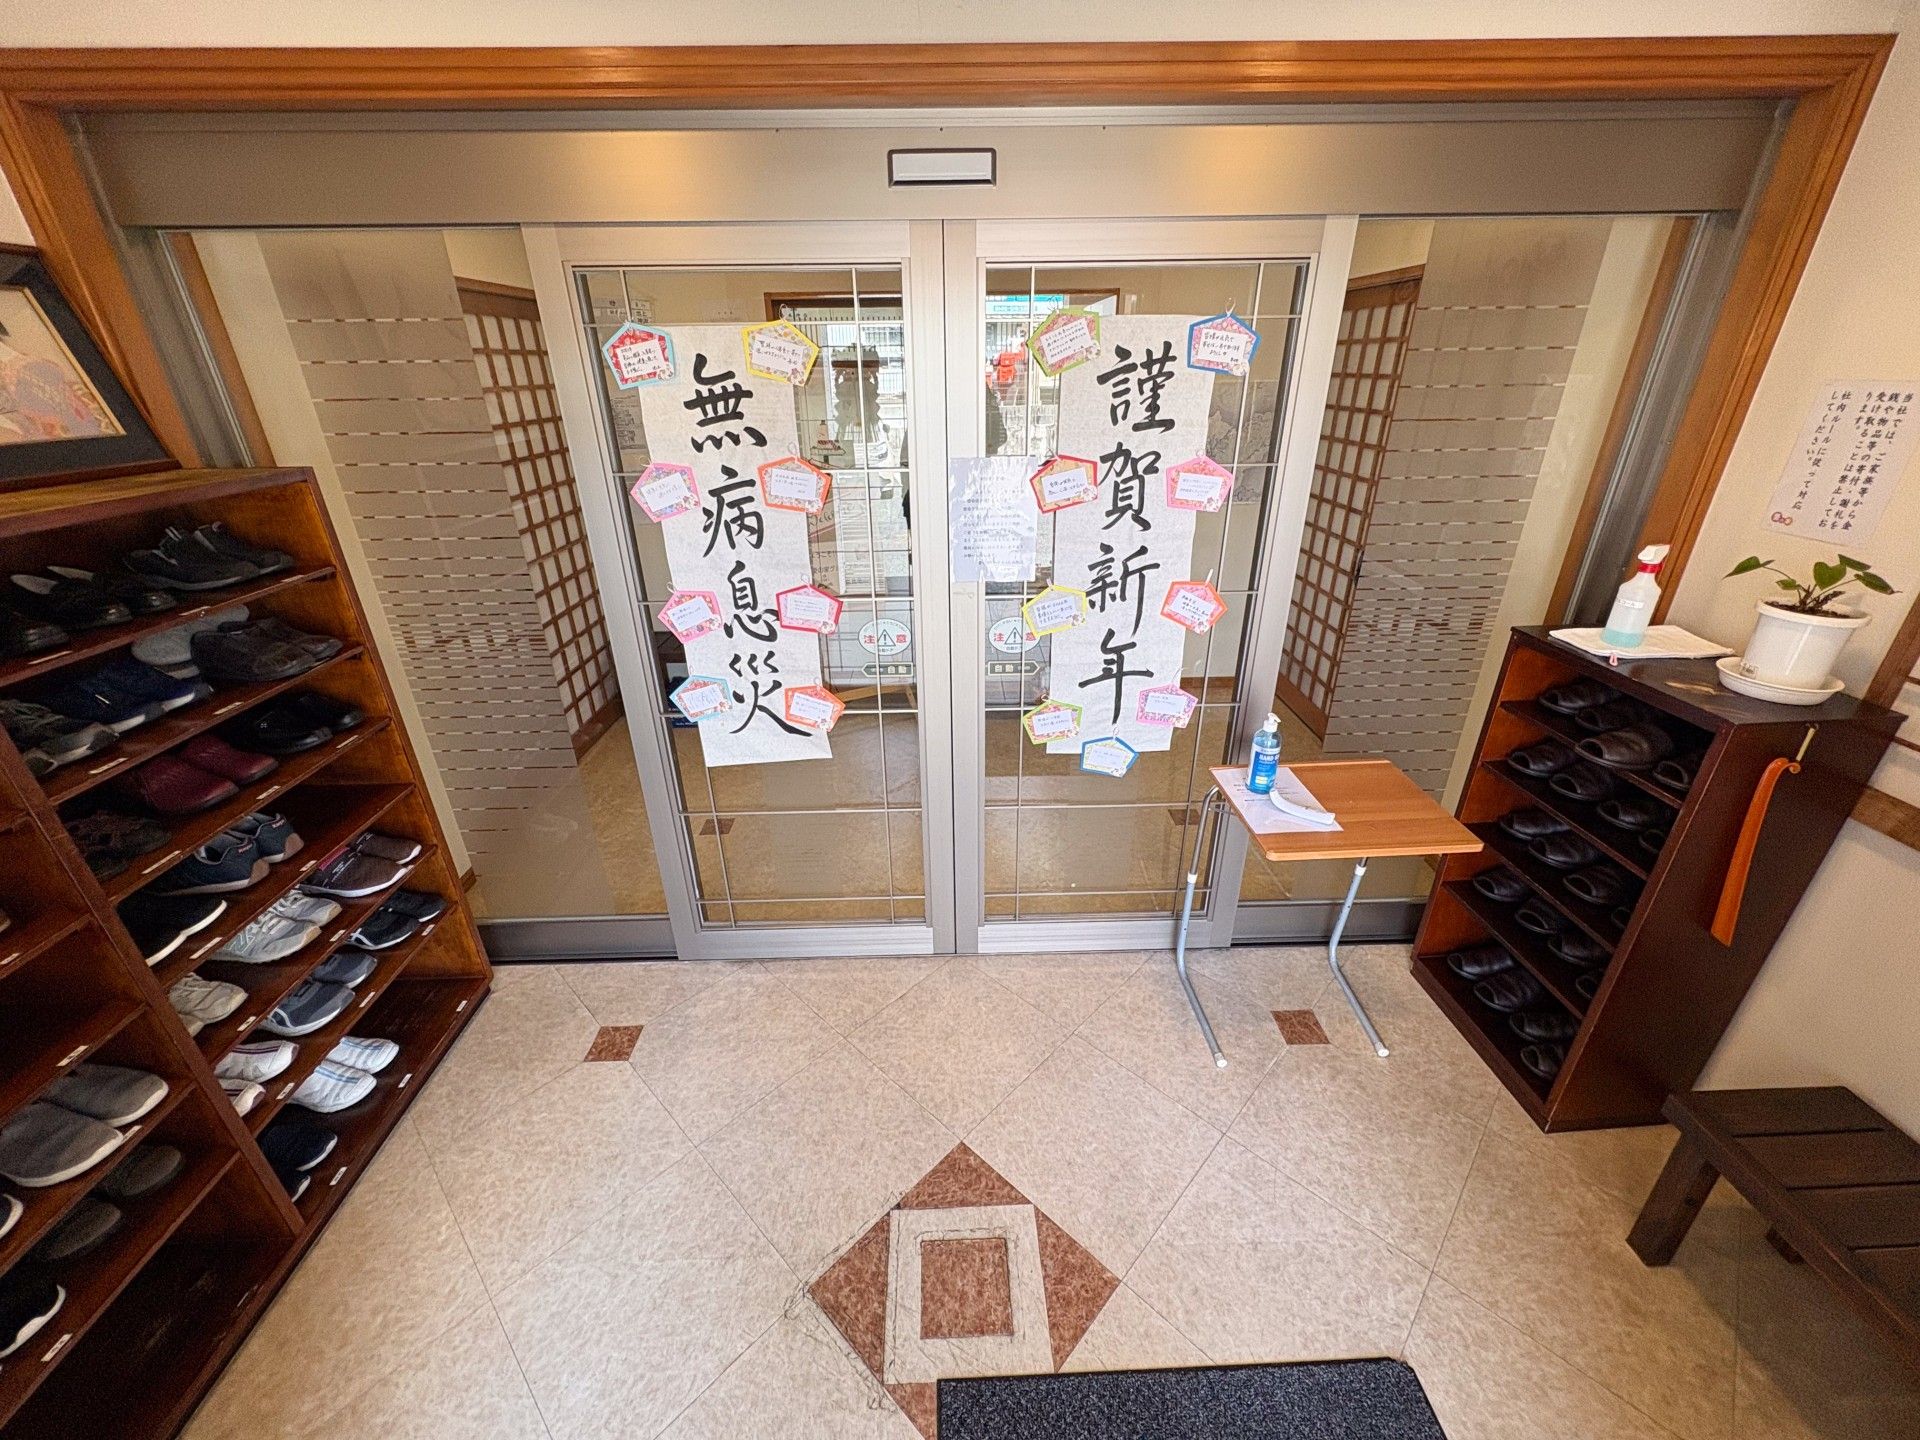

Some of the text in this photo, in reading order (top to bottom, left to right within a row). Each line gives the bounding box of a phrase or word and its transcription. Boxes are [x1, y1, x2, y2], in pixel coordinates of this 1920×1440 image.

[684, 353, 812, 737] 無病息災
[1078, 341, 1177, 724] 謹賀新年
[1792, 391, 1852, 510] 社内ルールに従って対応
[1807, 391, 1838, 460] してください。
